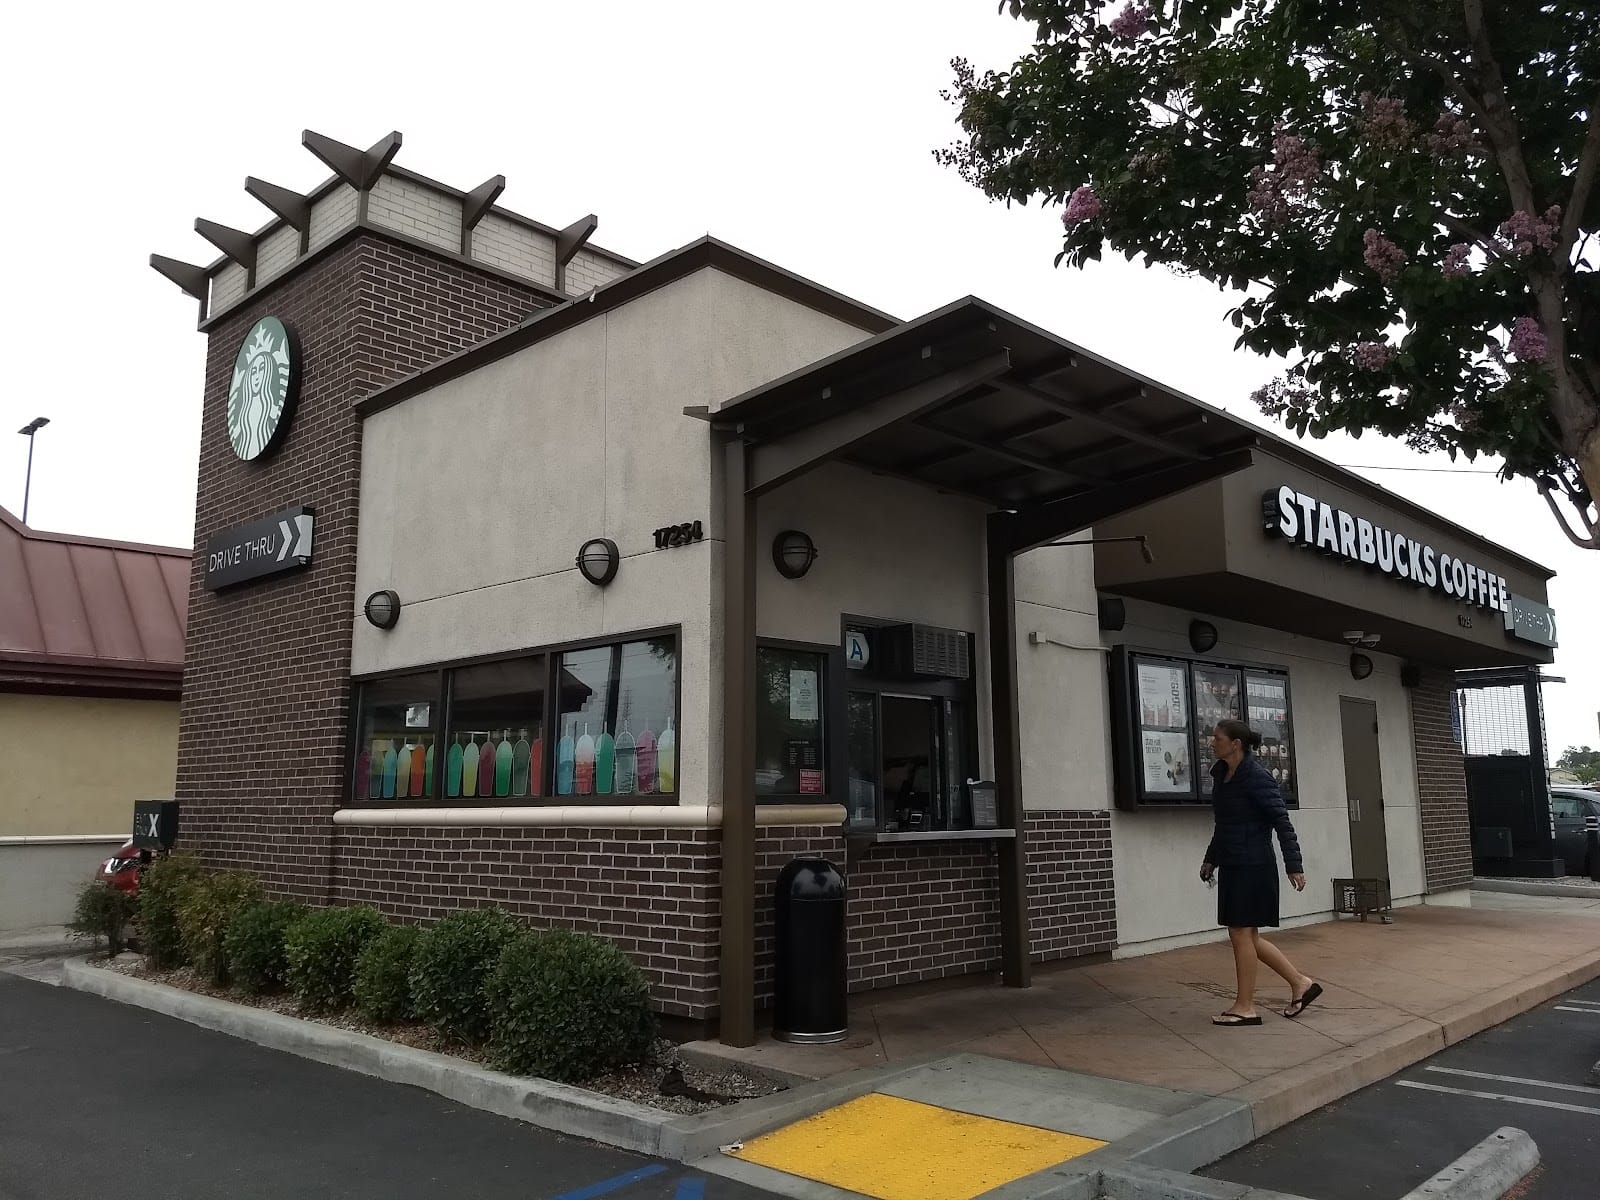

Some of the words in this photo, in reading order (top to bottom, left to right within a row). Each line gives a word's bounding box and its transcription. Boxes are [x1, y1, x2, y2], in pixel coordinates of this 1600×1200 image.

[208, 545, 242, 573] DRIVE
[244, 533, 276, 561] THRU
[1278, 485, 1437, 588] STARBUCKS
[1440, 553, 1508, 613] COFFEE
[850, 638, 864, 661] A
